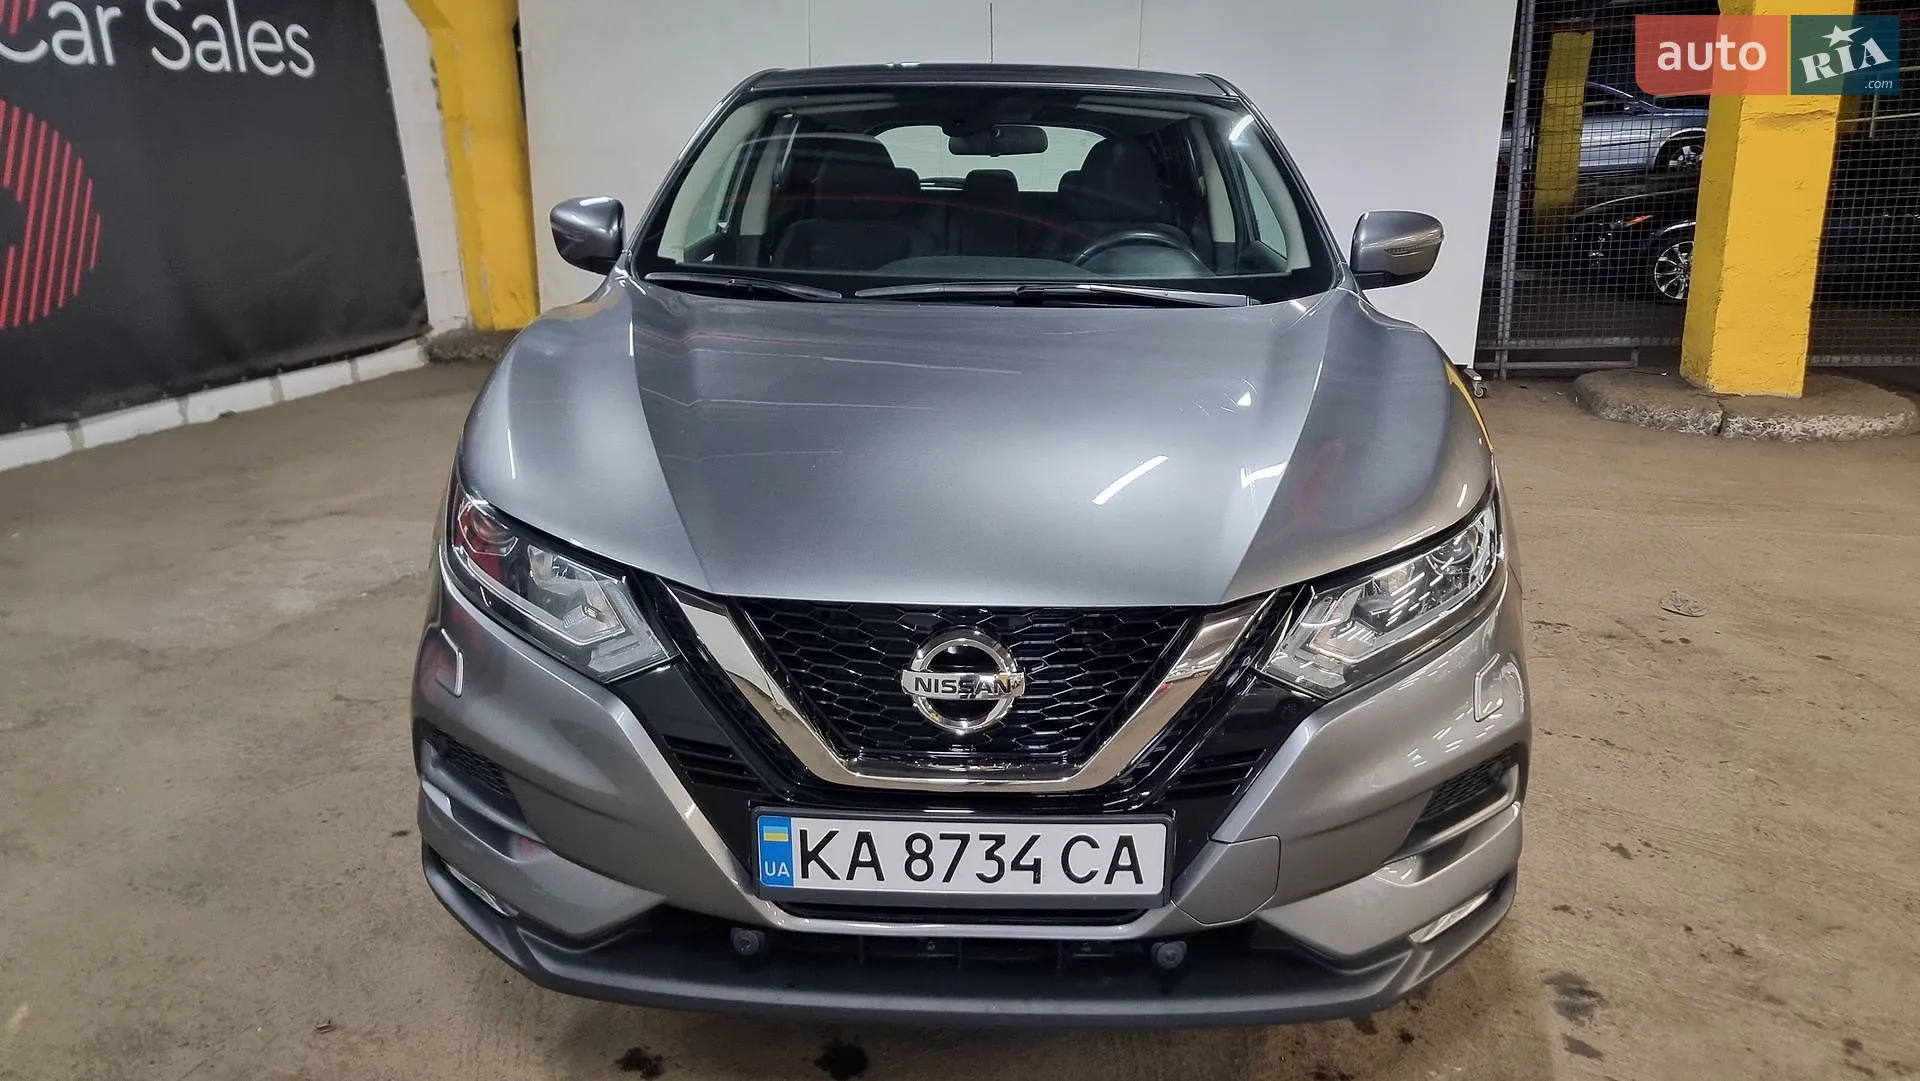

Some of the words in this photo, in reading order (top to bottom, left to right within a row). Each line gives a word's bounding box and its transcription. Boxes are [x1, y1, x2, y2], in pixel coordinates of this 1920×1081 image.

[145, 0, 315, 78] Sales
[914, 677, 1012, 694] NISSAN
[764, 861, 790, 877] UA
[799, 829, 885, 881] KA
[904, 832, 1043, 885] 8734
[1060, 834, 1144, 885] CA
